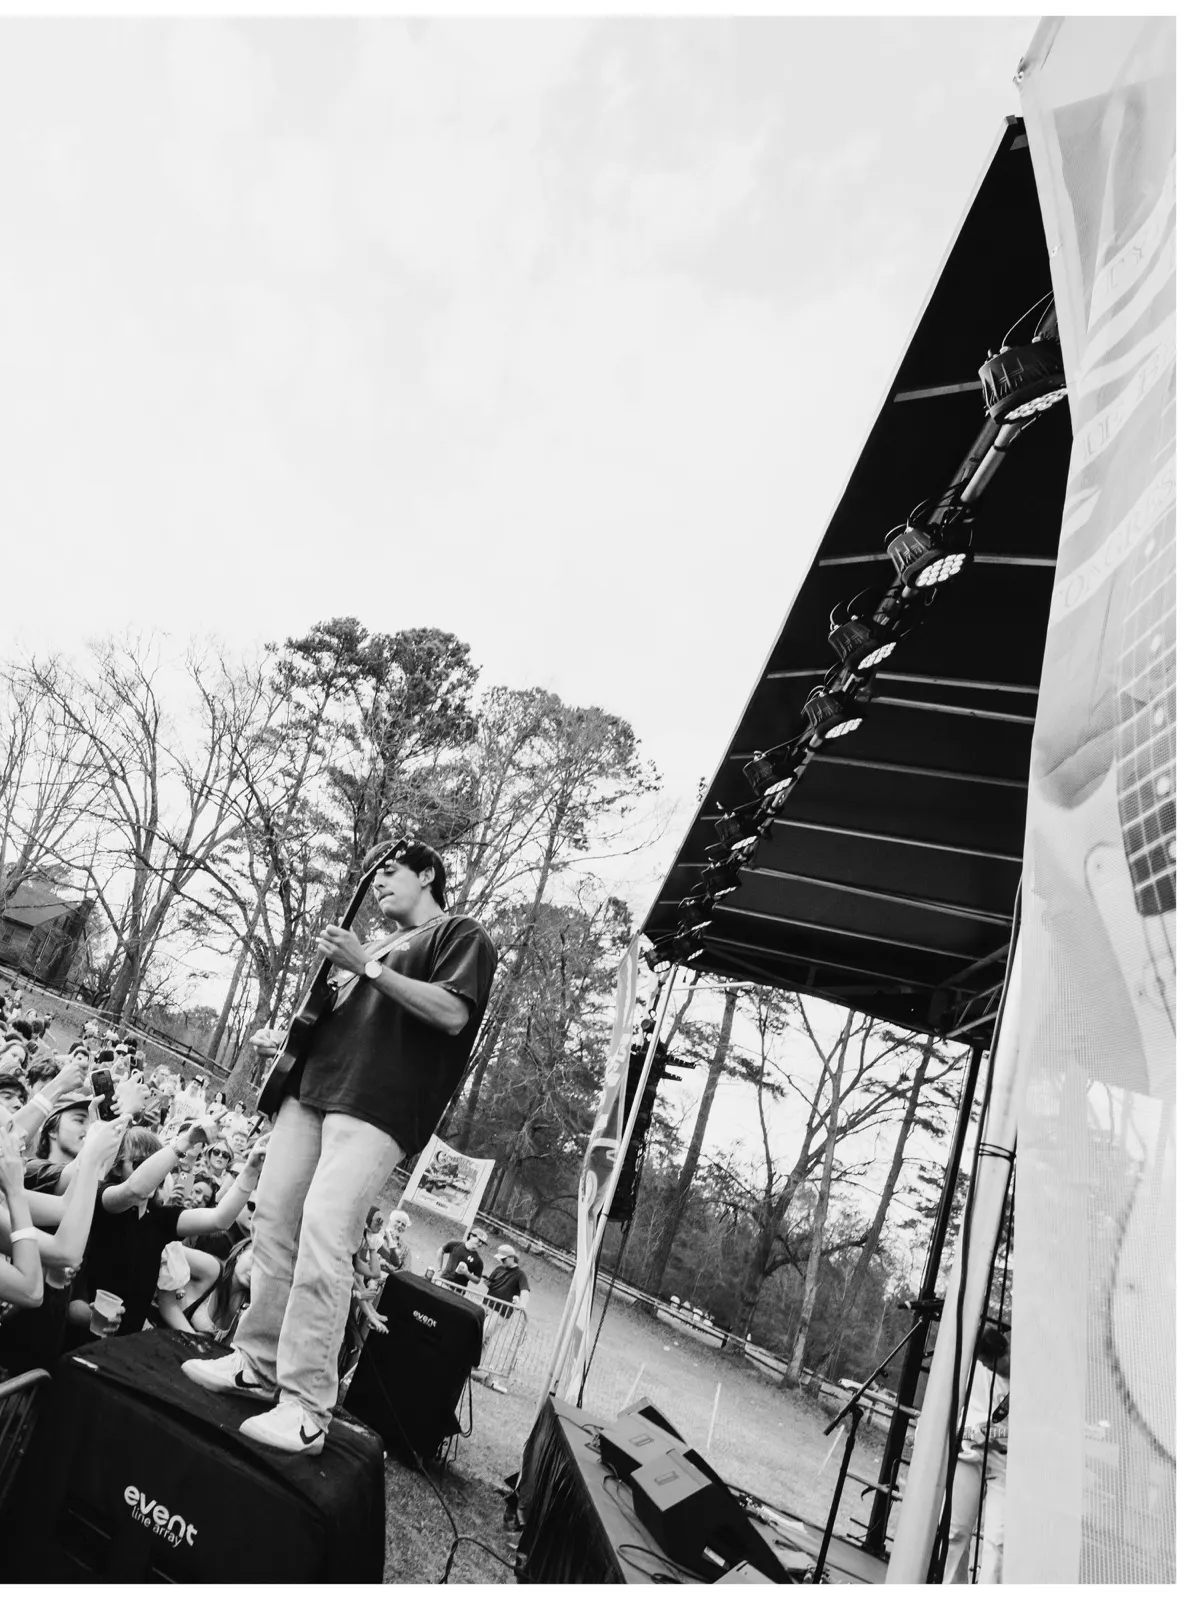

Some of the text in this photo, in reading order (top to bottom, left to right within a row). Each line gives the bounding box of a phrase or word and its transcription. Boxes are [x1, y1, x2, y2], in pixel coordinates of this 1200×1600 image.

[123, 1485, 198, 1547] event
[131, 1505, 182, 1548] line array
